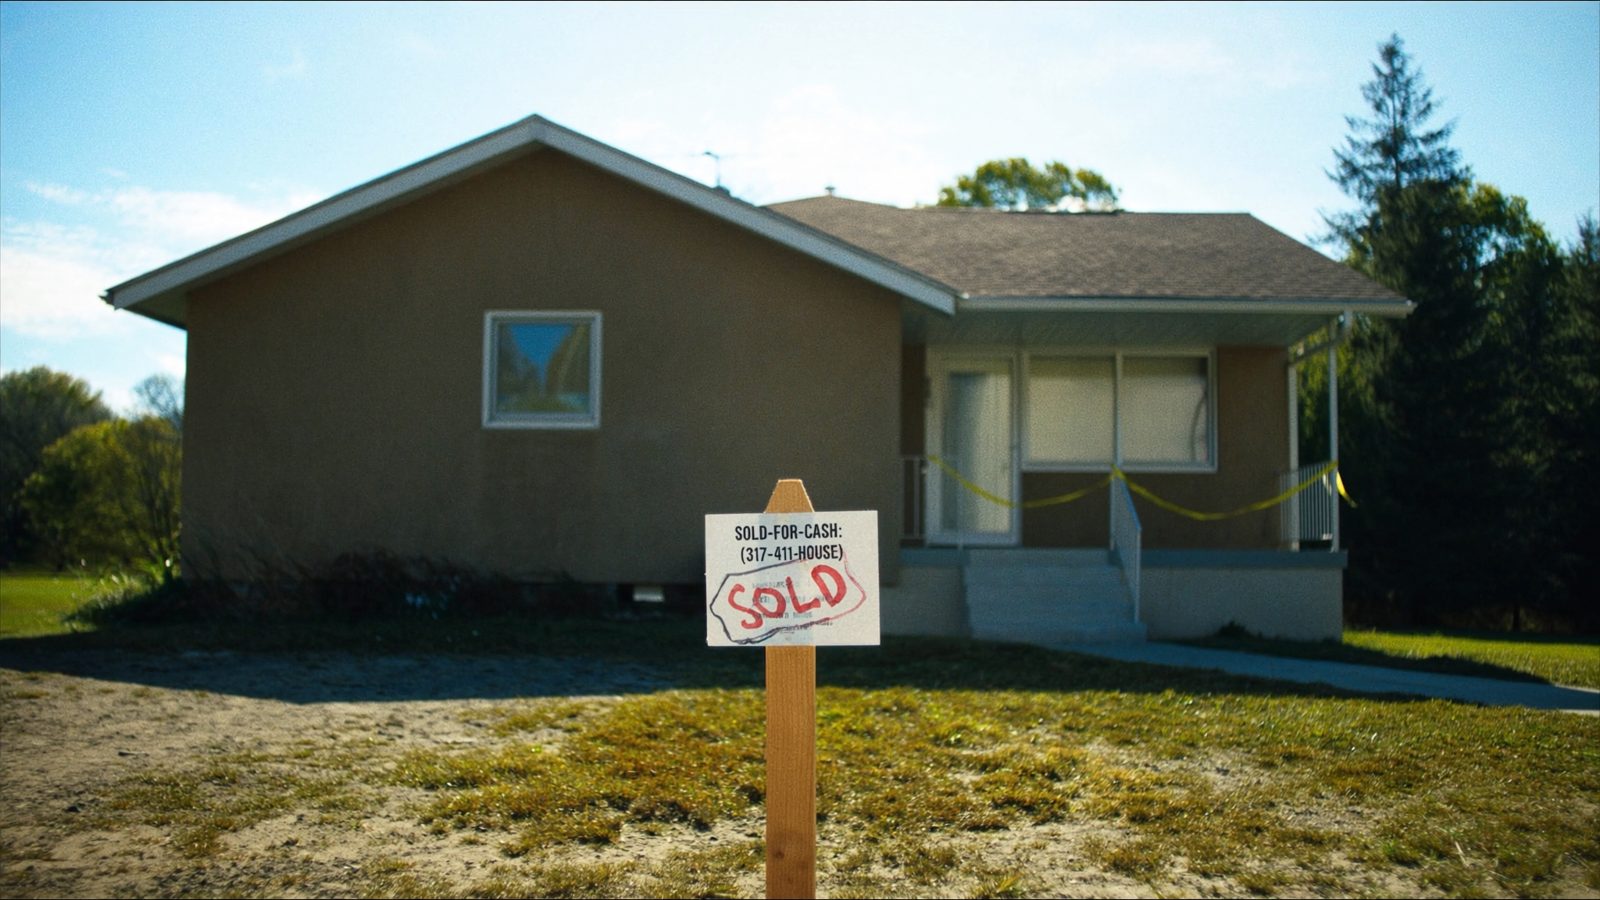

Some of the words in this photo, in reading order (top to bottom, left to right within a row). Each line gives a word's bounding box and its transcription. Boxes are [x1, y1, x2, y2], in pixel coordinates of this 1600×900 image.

[735, 523, 842, 541] SOLD-FOR-CASH:
[740, 544, 843, 564] (317-411-HOUSE)
[728, 564, 847, 629] SOLD
